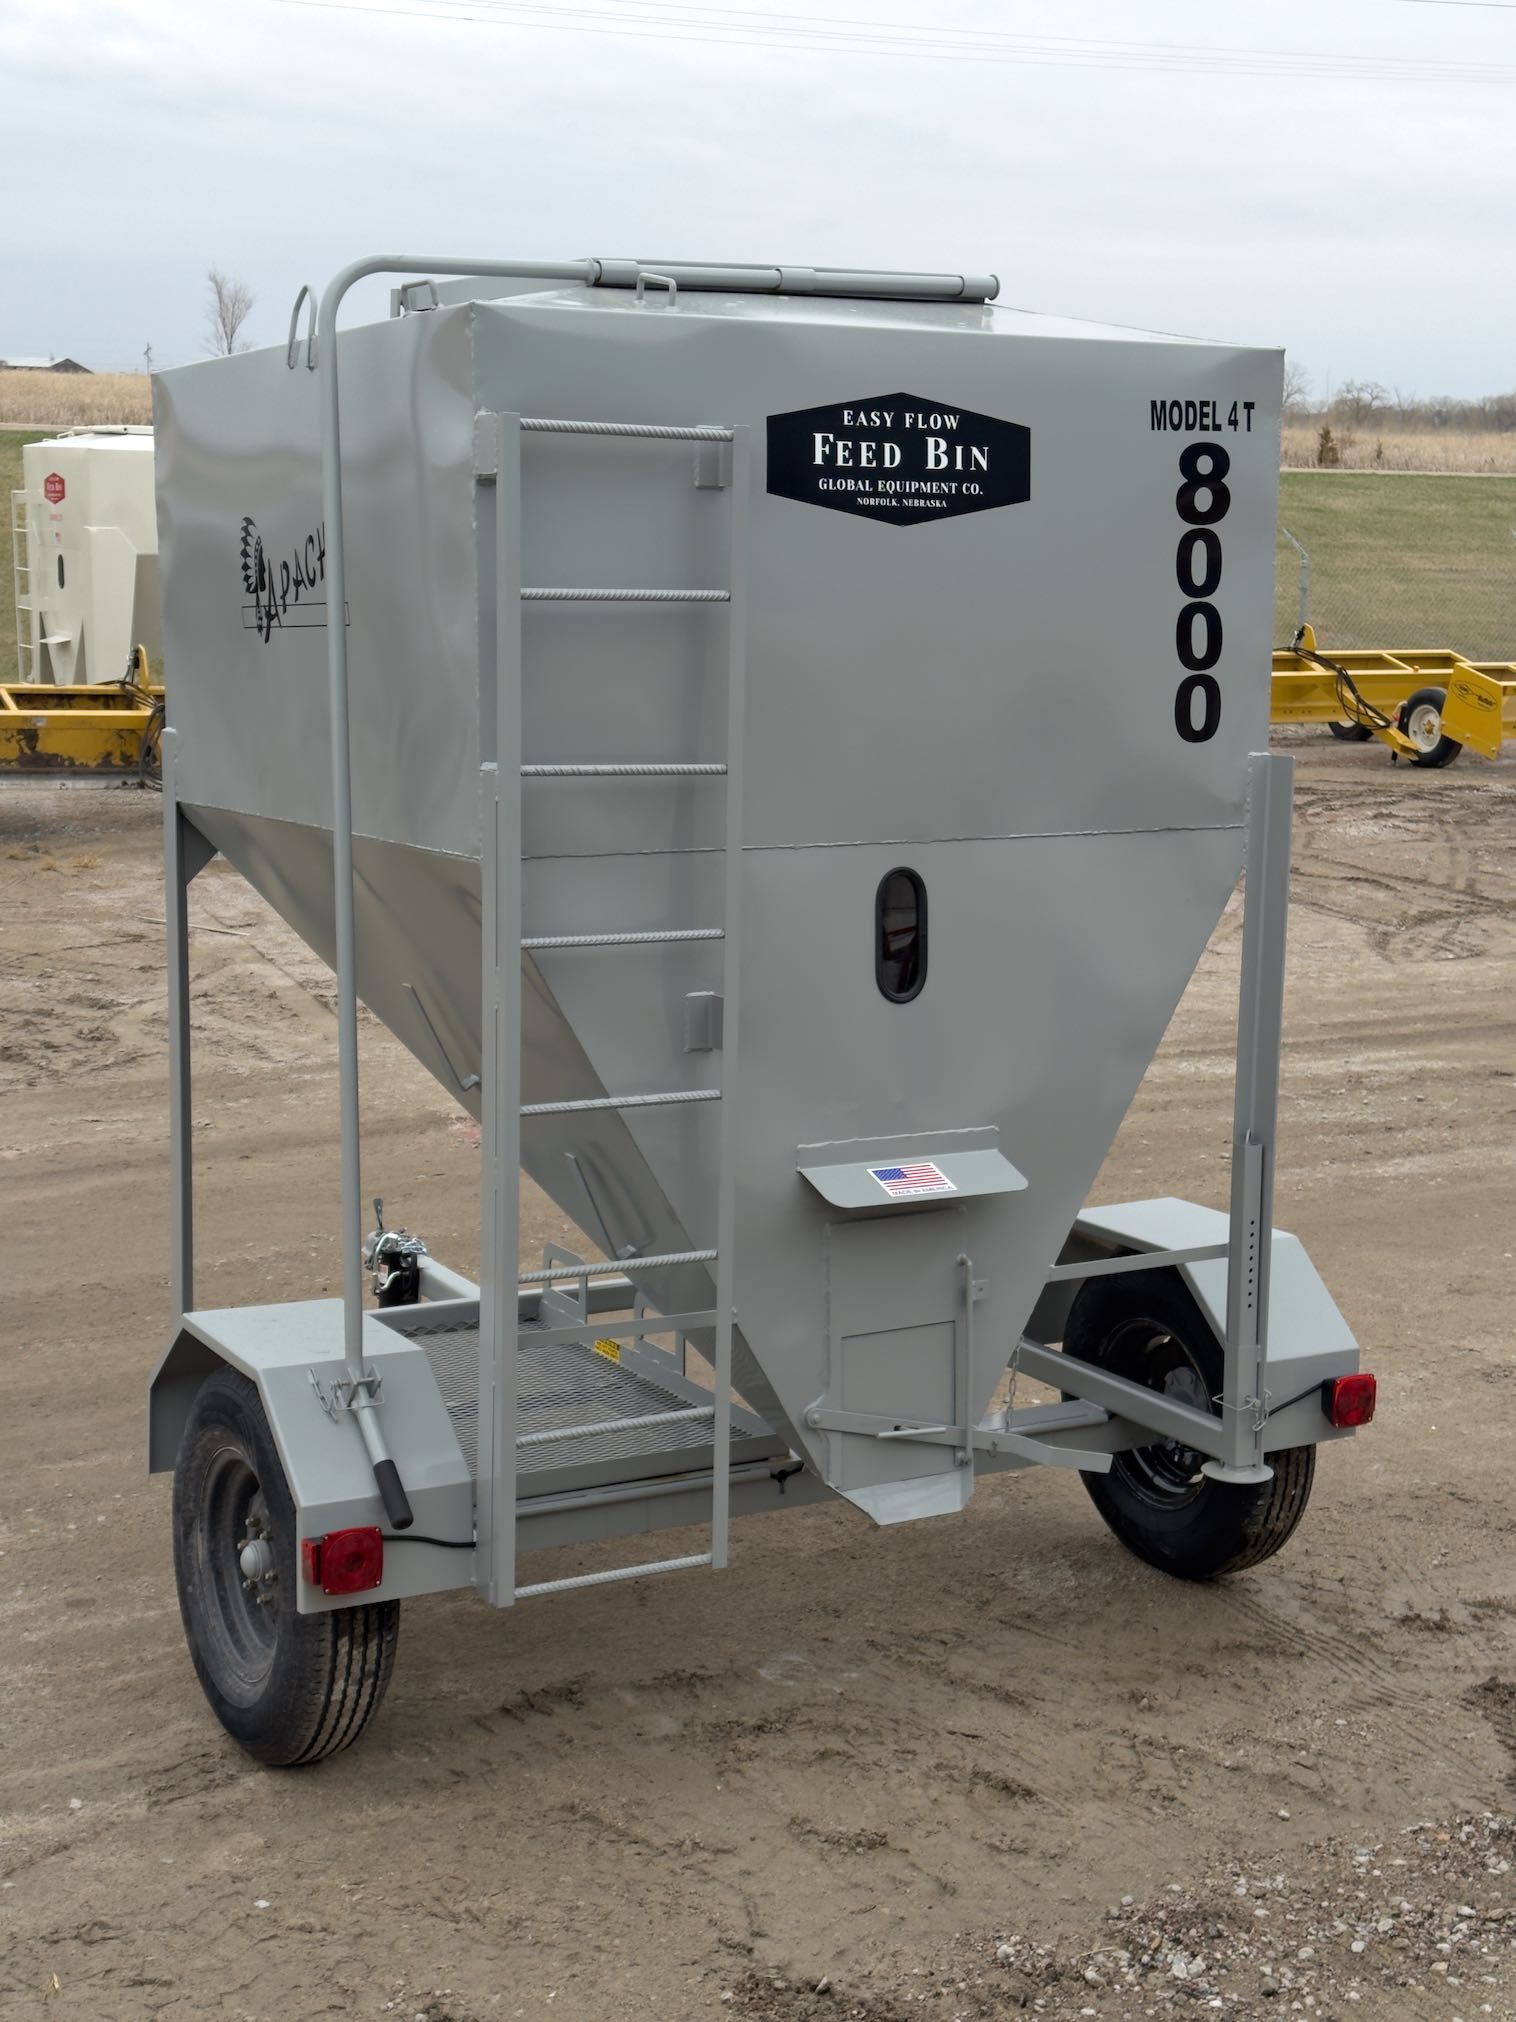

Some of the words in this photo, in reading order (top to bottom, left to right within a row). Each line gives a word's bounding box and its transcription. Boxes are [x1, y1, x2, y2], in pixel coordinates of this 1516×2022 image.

[843, 410, 894, 427] EASY
[904, 413, 960, 430] FLOW
[1150, 399, 1222, 432] MODEL
[812, 432, 901, 468] FEED
[925, 436, 989, 472] BIN
[818, 478, 873, 492] GLOBAL
[877, 480, 958, 495] EQUIPMENT
[962, 482, 984, 496] CO.
[902, 499, 948, 508] NEBRASKA
[264, 520, 326, 644] APACH
